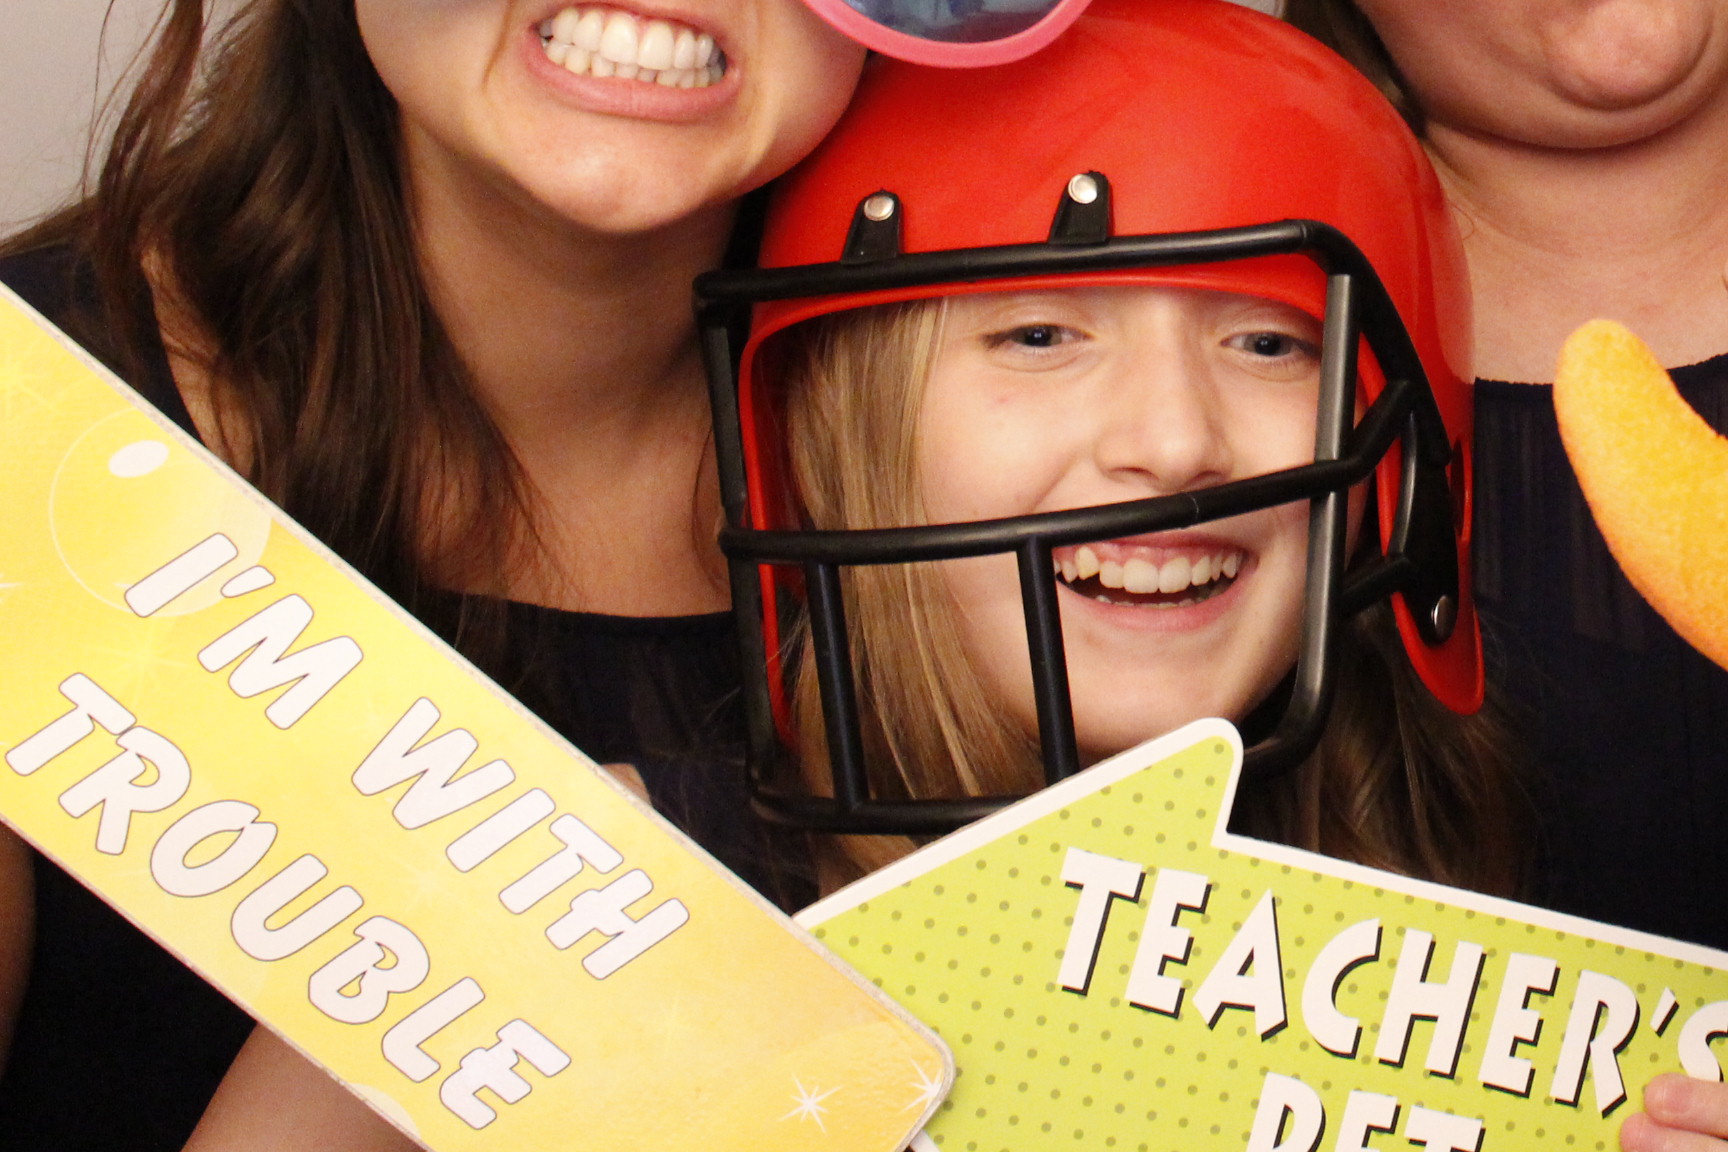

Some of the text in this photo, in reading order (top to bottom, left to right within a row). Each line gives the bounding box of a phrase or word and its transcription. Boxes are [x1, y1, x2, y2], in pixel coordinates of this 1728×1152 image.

[4, 672, 572, 1130] TROUBLE
[124, 532, 691, 981] I'M WITH
